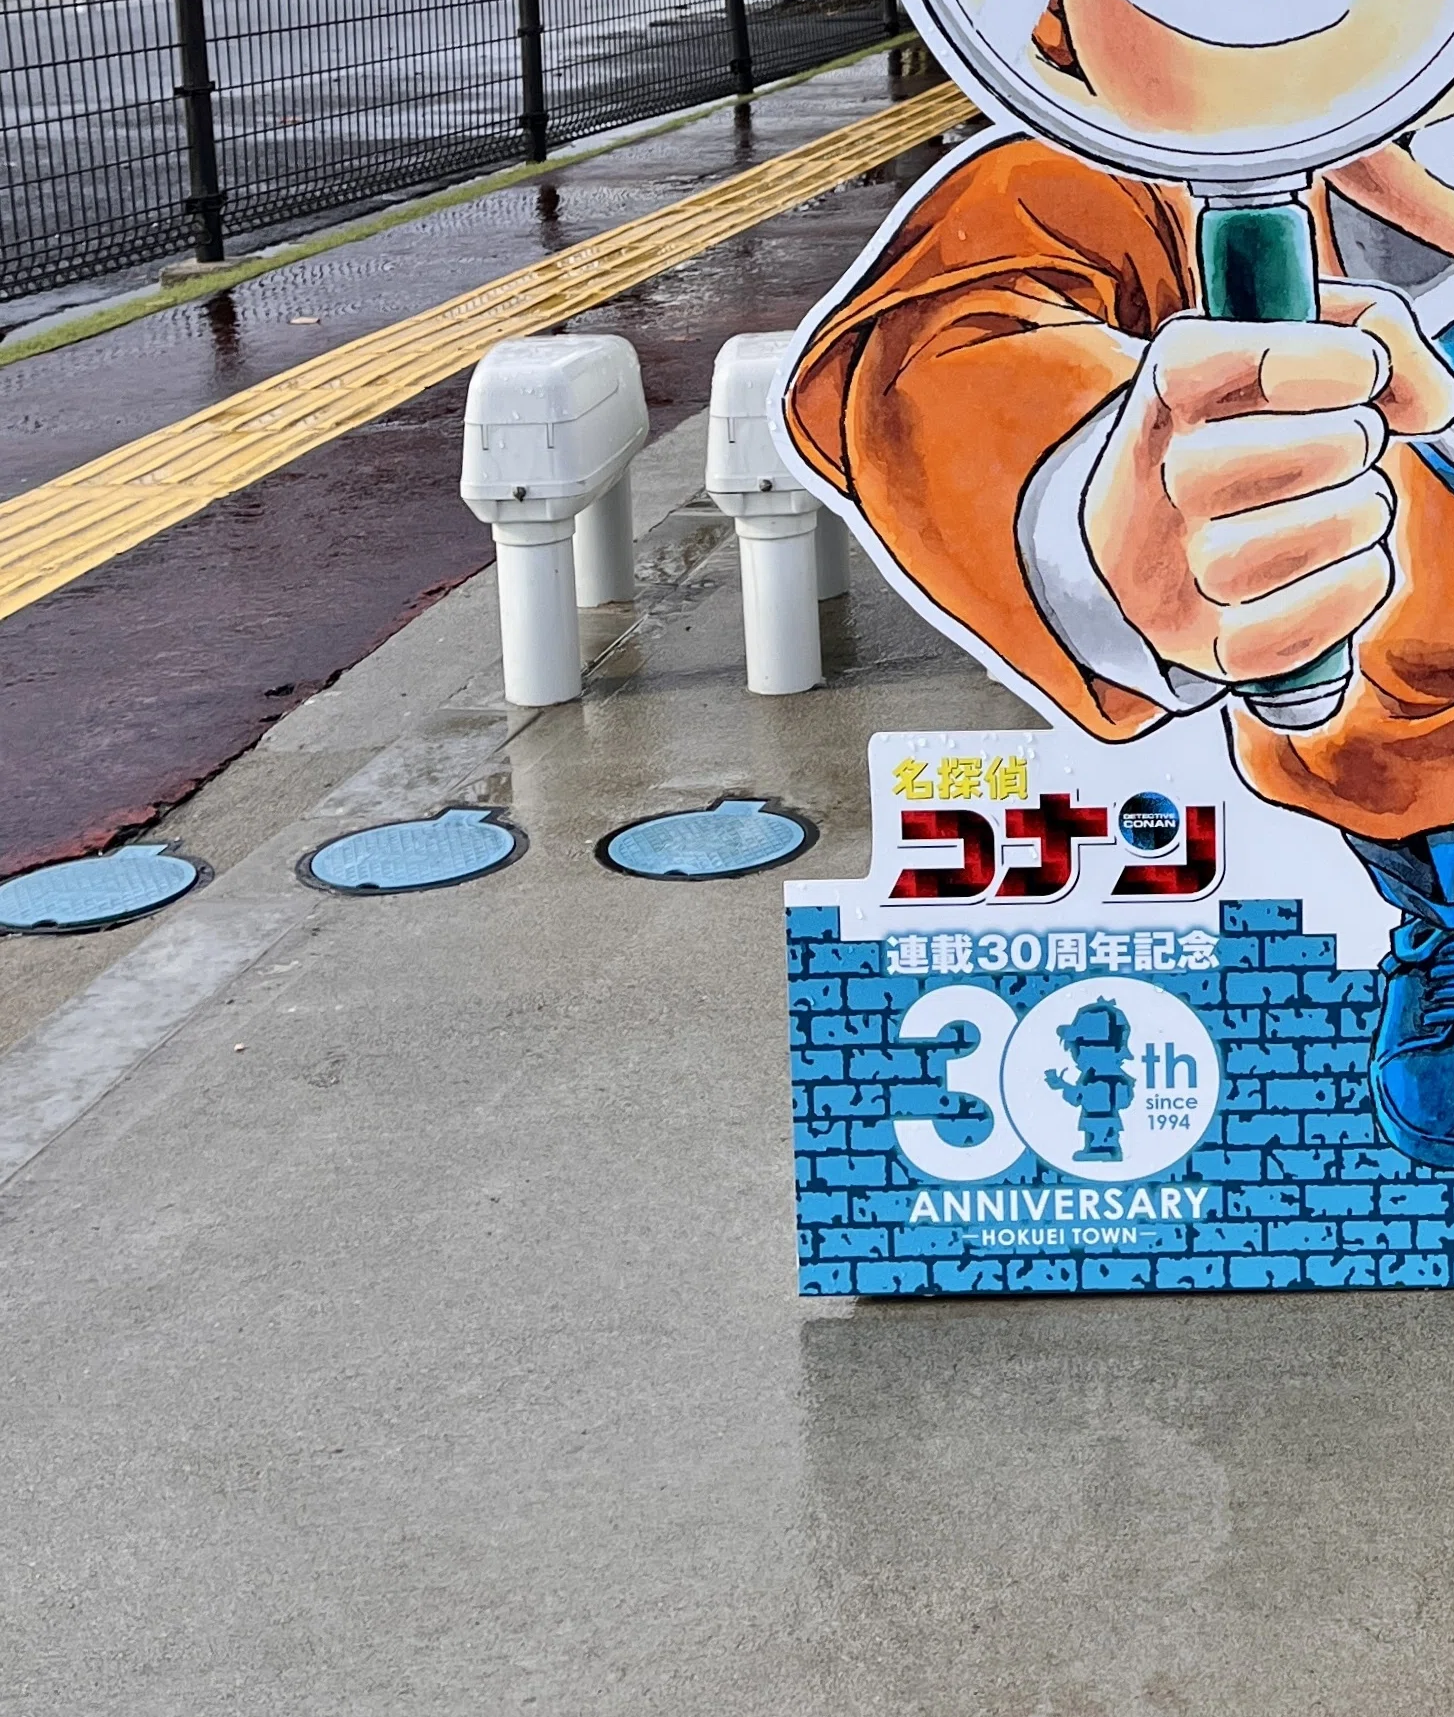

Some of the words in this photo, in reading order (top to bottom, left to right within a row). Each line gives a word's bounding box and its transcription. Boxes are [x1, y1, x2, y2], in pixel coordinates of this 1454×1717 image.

[892, 756, 1029, 800] 名探偵
[1123, 819, 1176, 828] CONAN
[888, 793, 1217, 899] コナン
[886, 931, 1220, 974] 連載30周年記念
[1146, 1094, 1198, 1110] since
[1147, 1114, 1191, 1131] 1994
[909, 1187, 1209, 1223] ANNIVERSARY
[982, 1228, 1065, 1246] HOKUEI
[1071, 1227, 1137, 1245] TOWN
